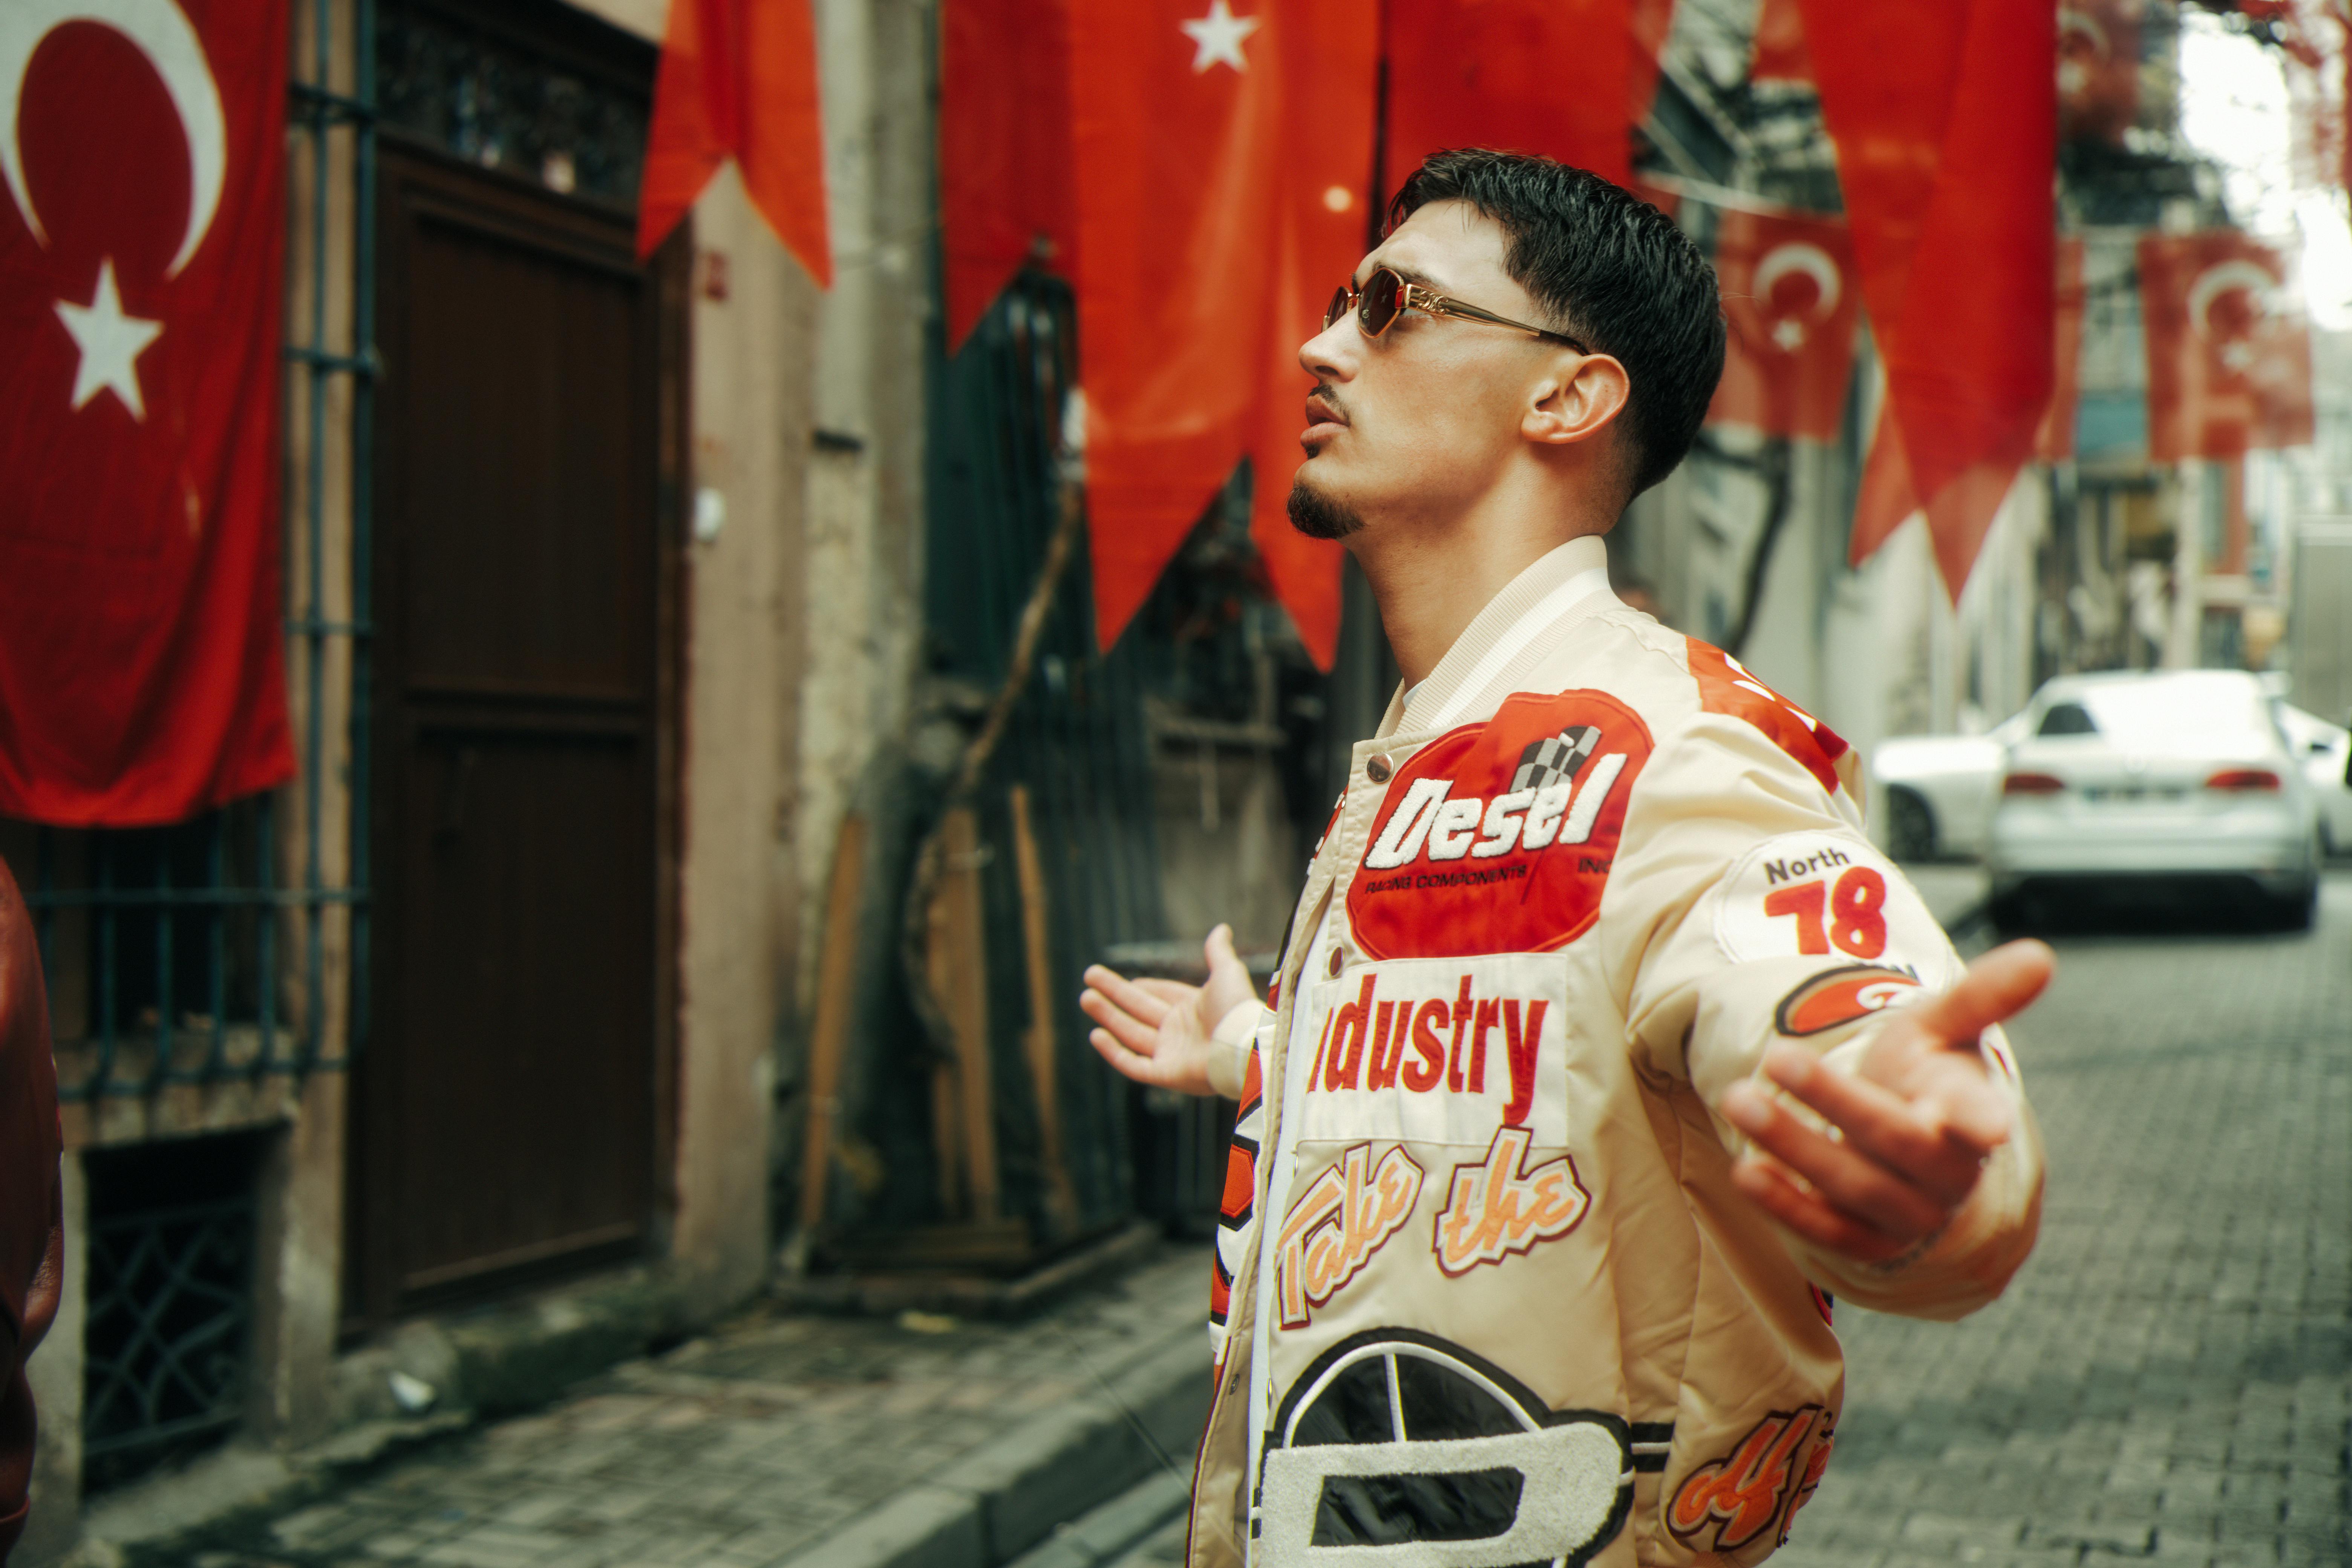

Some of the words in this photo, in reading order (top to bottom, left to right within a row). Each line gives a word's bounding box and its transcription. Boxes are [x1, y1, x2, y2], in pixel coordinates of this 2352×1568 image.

[1365, 875, 1410, 894] RACING
[1416, 865, 1526, 888] COMPONENTS
[1764, 848, 1850, 884] North
[1765, 866, 1886, 959] 78
[1307, 974, 1549, 1125] dustry
[1276, 1143, 1423, 1328] Take
[1435, 1126, 1590, 1276] the
